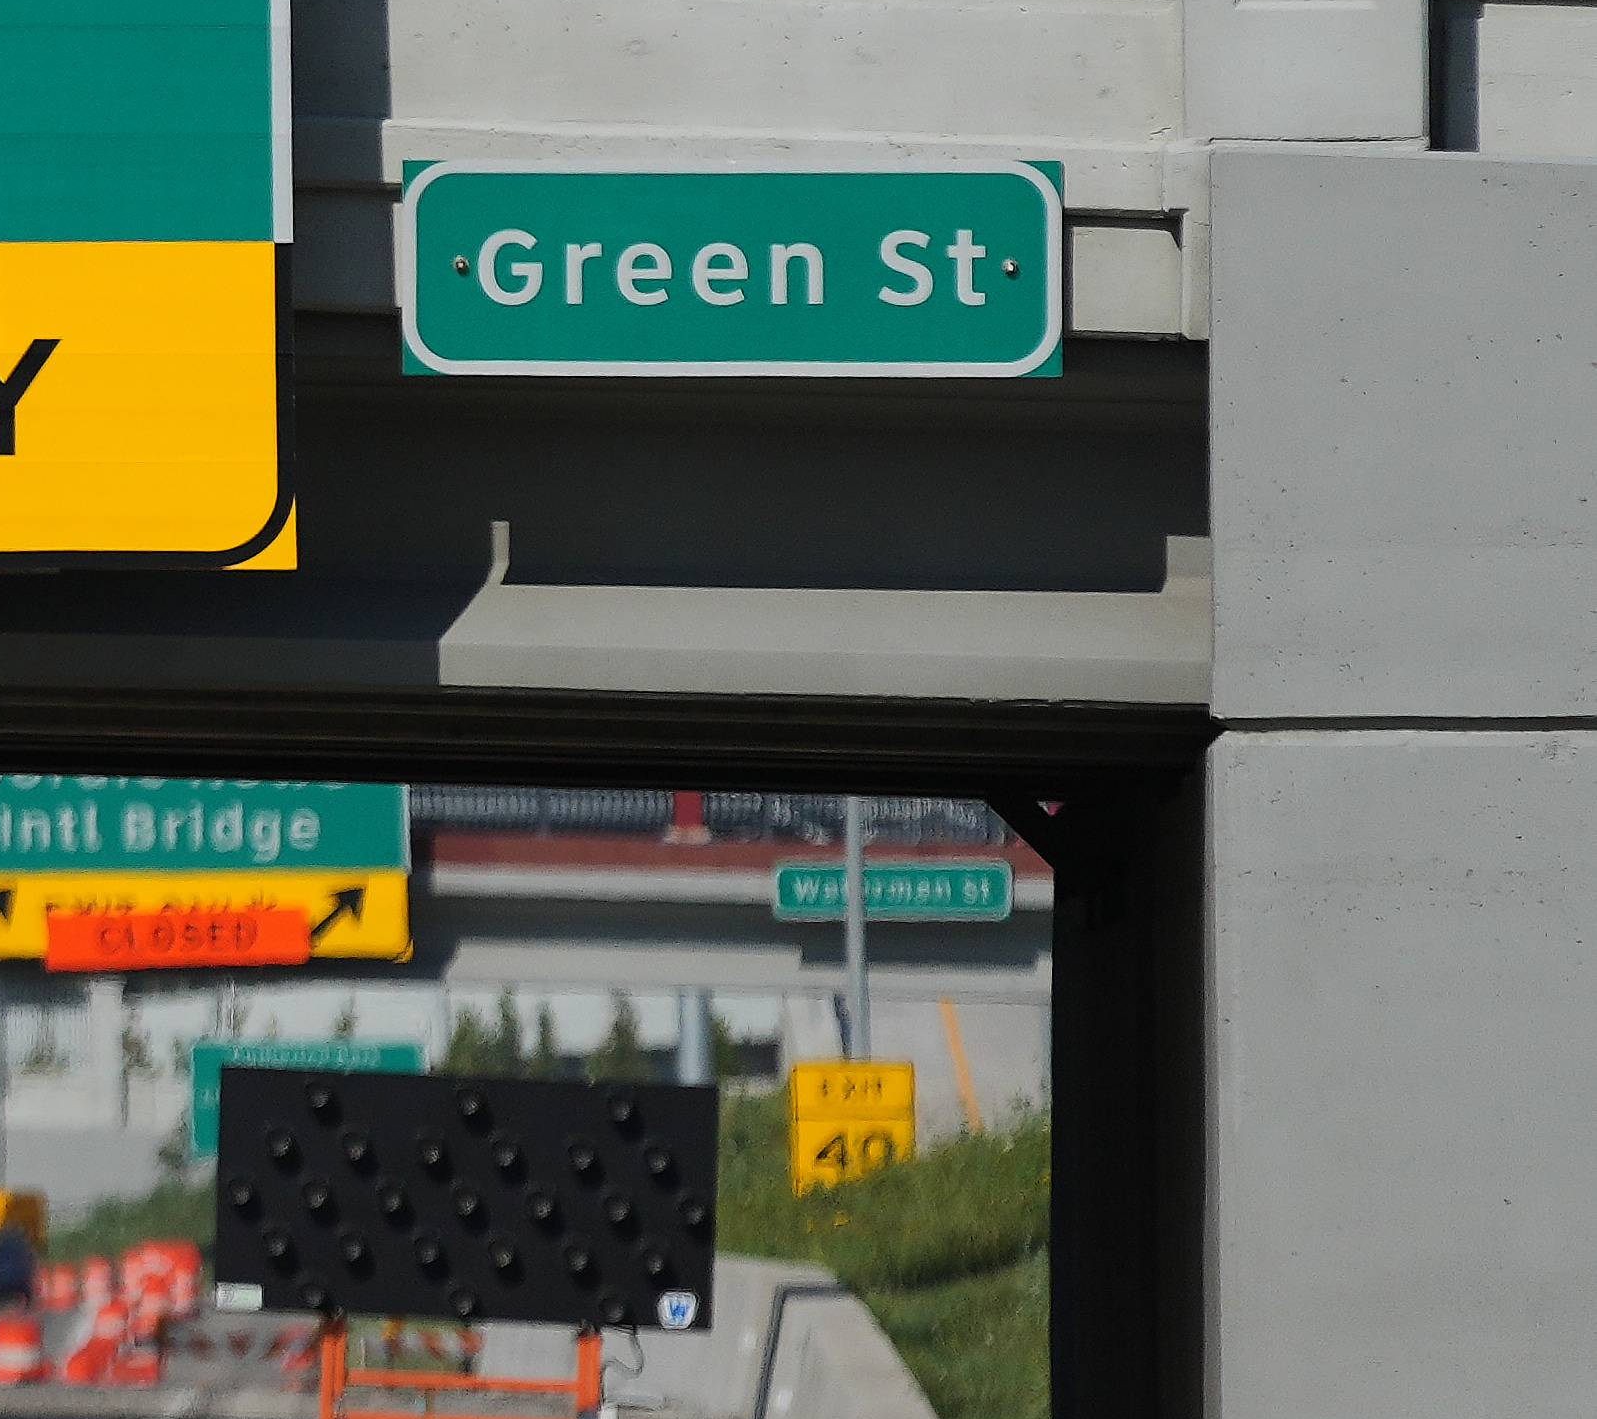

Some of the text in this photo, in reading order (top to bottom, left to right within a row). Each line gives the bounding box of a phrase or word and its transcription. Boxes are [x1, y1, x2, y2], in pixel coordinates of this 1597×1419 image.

[476, 228, 987, 307] Green St
[123, 800, 322, 863] Bridge
[814, 1130, 894, 1172] 40
